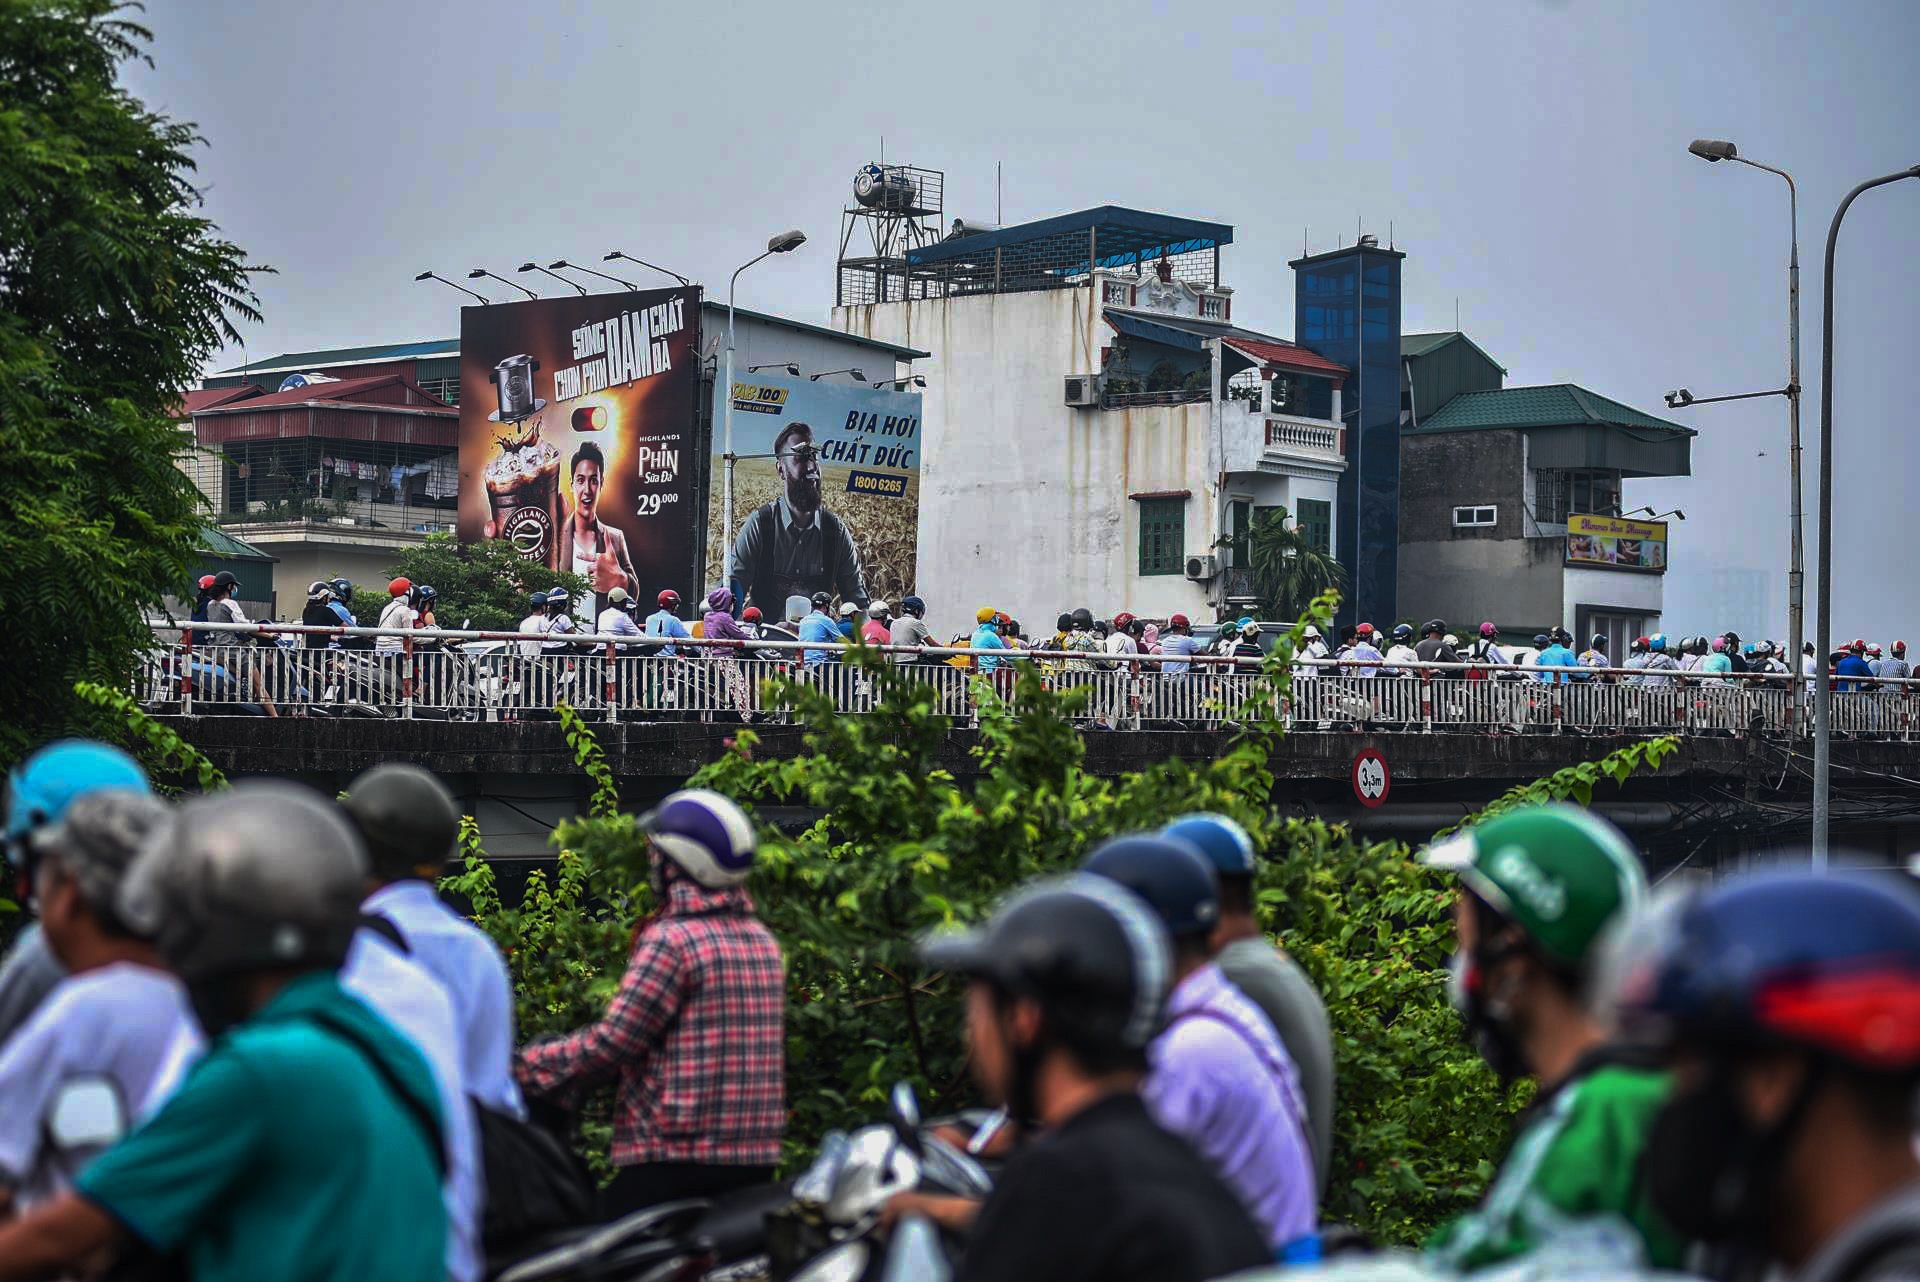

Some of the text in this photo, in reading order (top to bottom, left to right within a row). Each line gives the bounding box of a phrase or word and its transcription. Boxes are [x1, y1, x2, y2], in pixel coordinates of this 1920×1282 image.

[571, 320, 606, 360] SỐNG
[649, 294, 684, 338] CHẤT
[581, 357, 608, 395] PHIN
[640, 434, 680, 442] HIGHLANDS
[844, 410, 918, 438] BIA HƠI
[639, 444, 678, 477] PHIN
[821, 436, 914, 470] CHẤT ĐỨC
[854, 475, 902, 493] 1800 6265
[505, 510, 550, 537] HIGHLANDS
